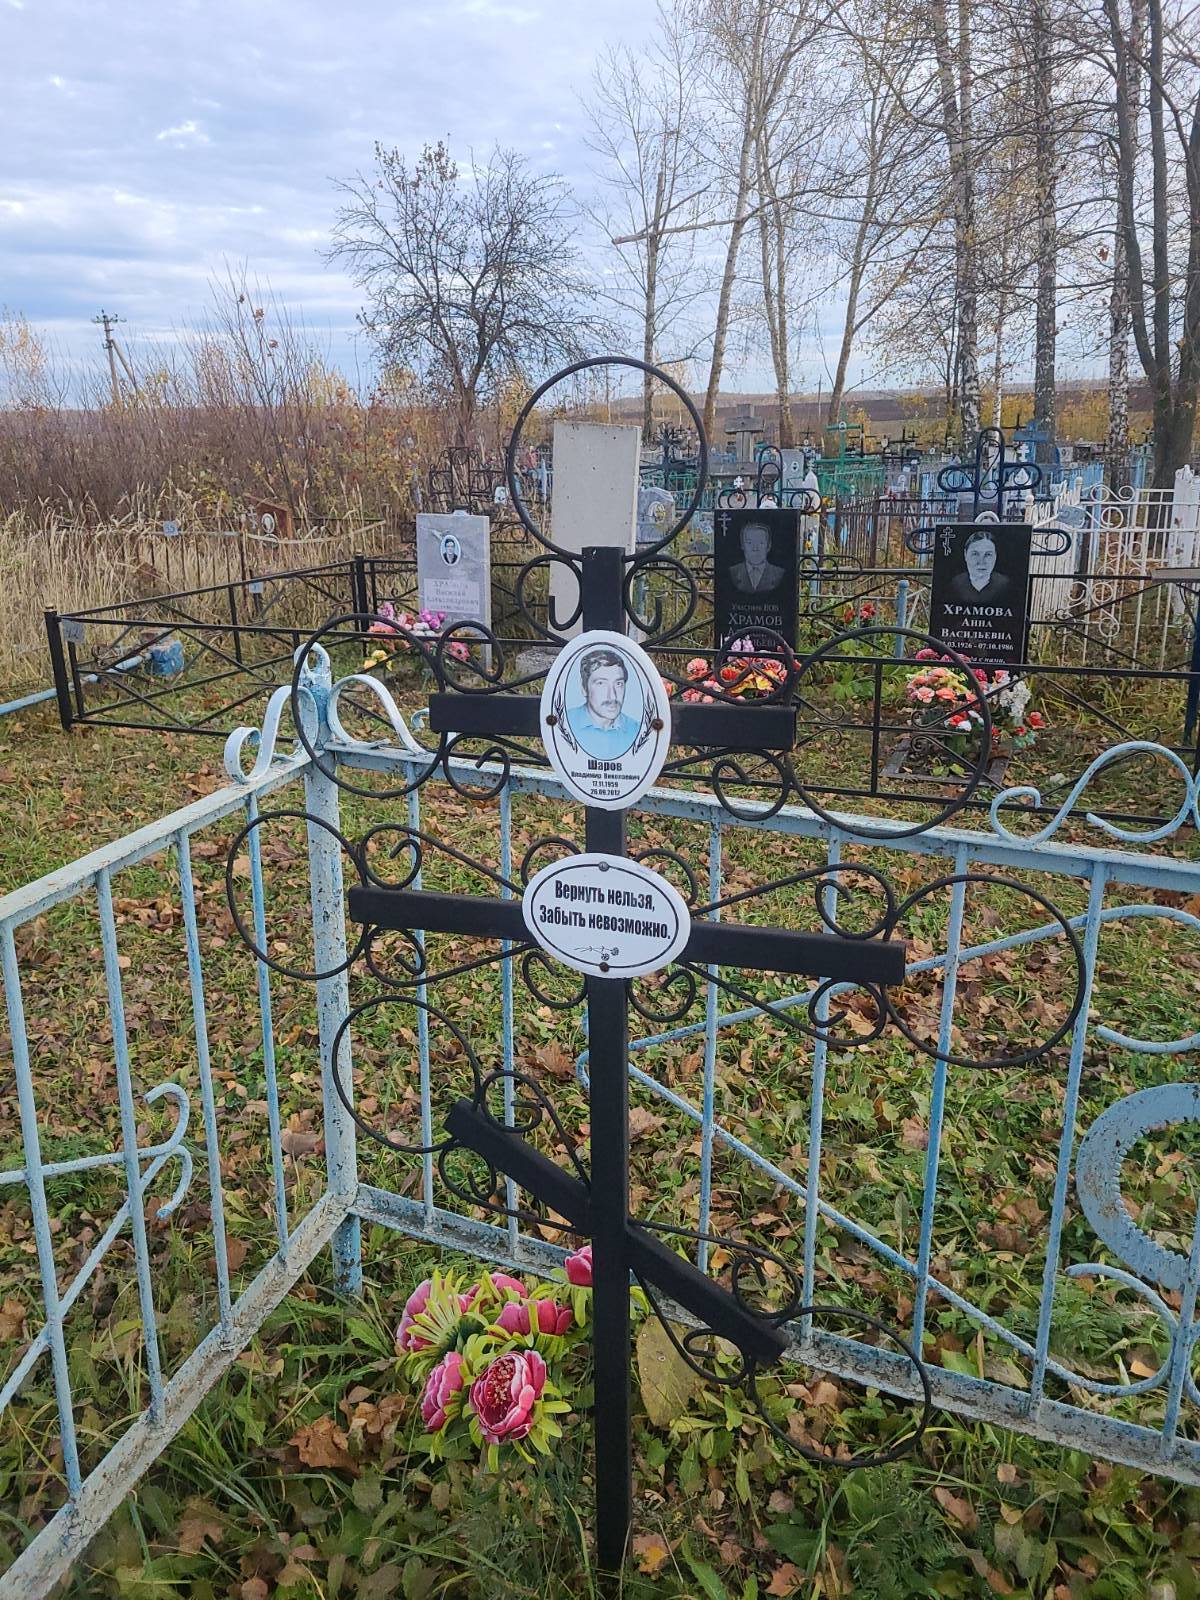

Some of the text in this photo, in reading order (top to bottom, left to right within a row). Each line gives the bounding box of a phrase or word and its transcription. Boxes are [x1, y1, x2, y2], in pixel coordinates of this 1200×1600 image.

[943, 603, 1014, 617] ХРАМОВА
[728, 612, 783, 626] ХРАМОВ
[943, 641, 973, 649] .03.1926
[978, 642, 1014, 651] 07.10.1986
[587, 760, 622, 772] Шаров
[571, 771, 602, 779] Владимир
[555, 879, 656, 912] Вернуть нельзя,
[539, 904, 671, 940] Забыть невозможно.
